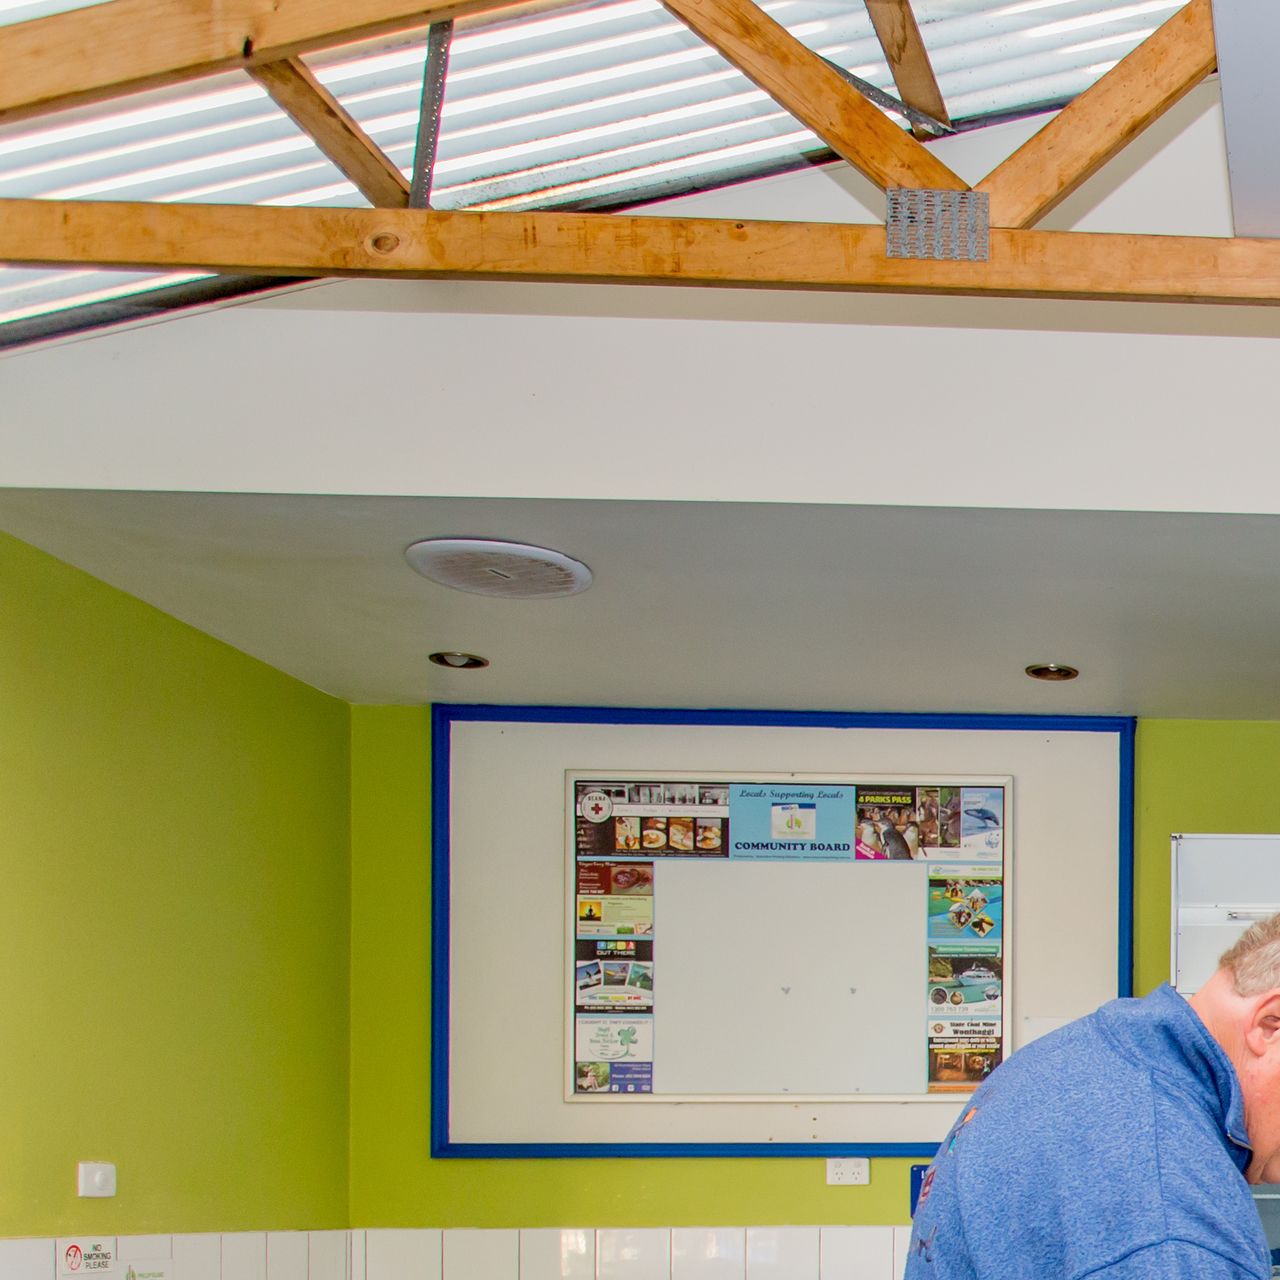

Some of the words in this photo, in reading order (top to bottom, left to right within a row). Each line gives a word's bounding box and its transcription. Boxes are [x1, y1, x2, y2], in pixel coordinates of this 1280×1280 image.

[740, 789, 767, 798] Locals
[769, 790, 814, 800] Supporting
[816, 791, 844, 799] Locals
[865, 795, 891, 804] PARKS
[891, 795, 912, 804] PASS
[735, 841, 808, 851] COMMUNITY
[810, 843, 851, 852] BOARD
[92, 1244, 102, 1252] NO
[83, 1252, 112, 1261] SMOKING
[85, 1261, 109, 1269] PLEASE
